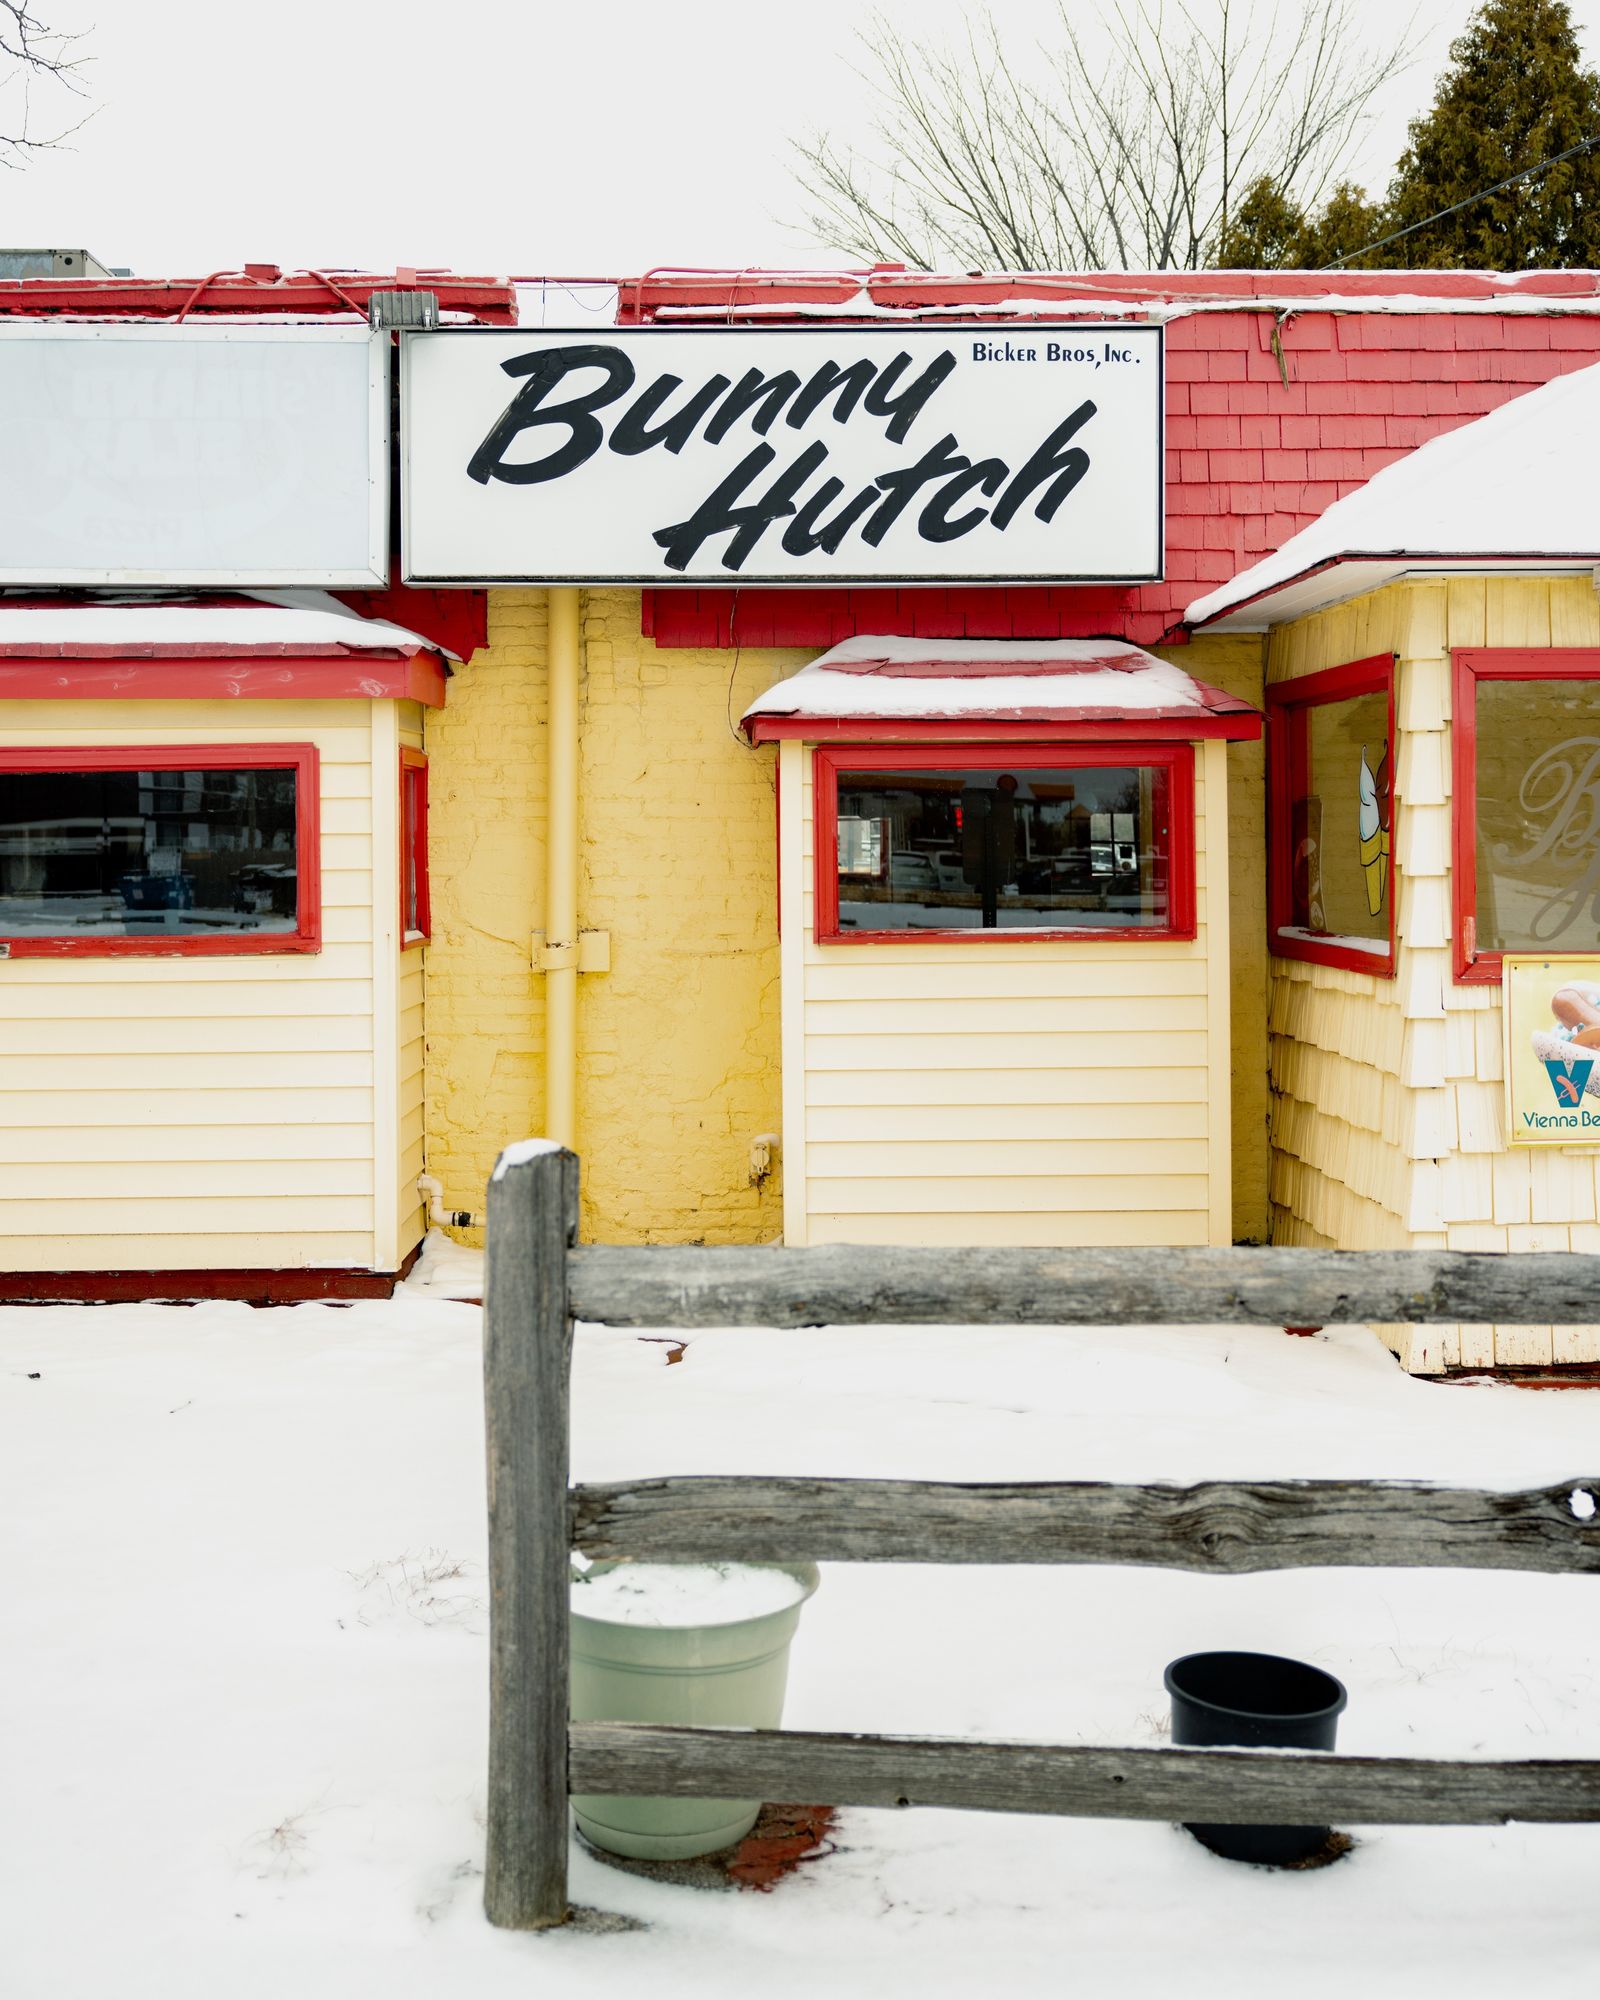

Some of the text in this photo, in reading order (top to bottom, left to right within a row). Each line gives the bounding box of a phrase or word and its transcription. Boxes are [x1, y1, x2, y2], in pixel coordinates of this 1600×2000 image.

[466, 344, 958, 486] Bunny
[652, 400, 1098, 572] Hutch
[1523, 1112, 1578, 1128] Vienna
